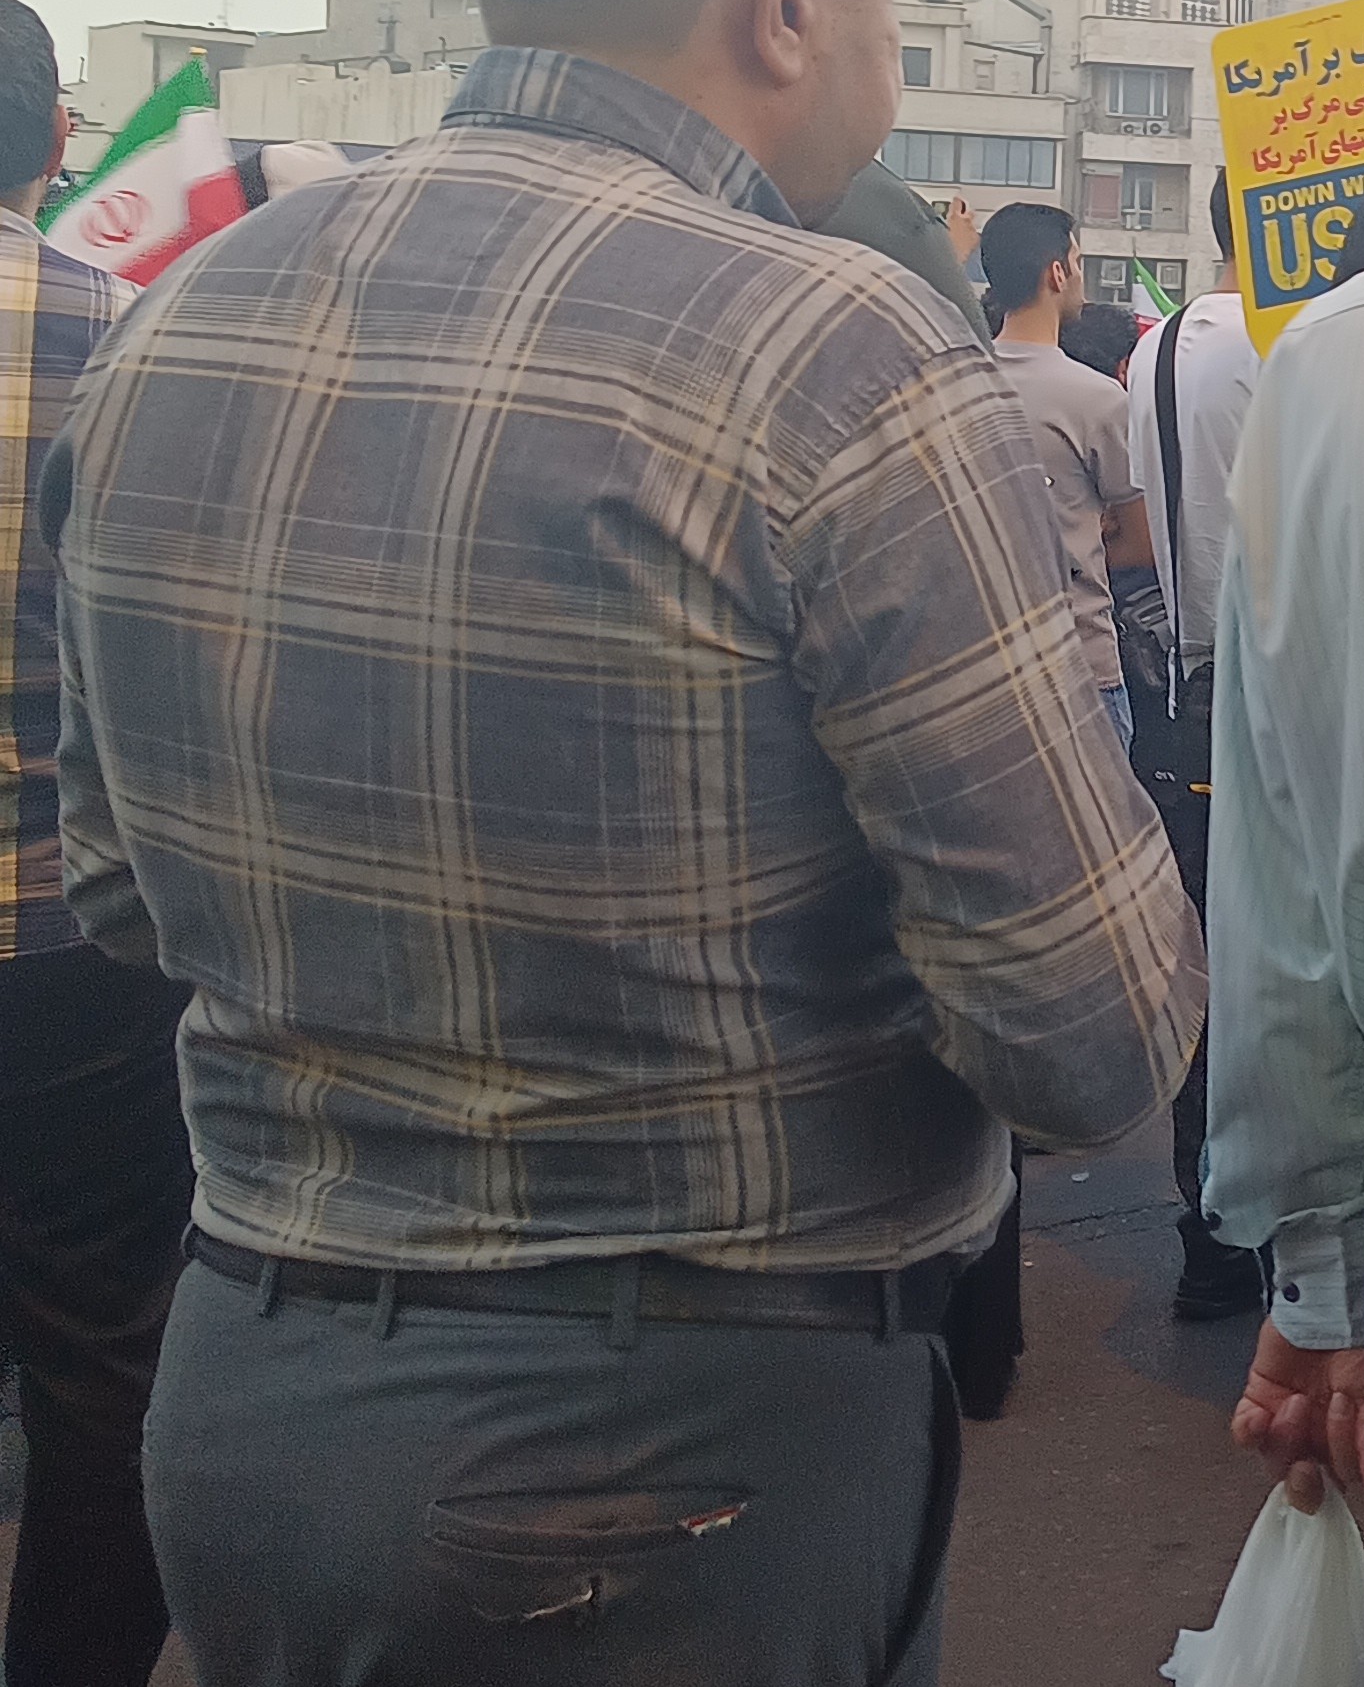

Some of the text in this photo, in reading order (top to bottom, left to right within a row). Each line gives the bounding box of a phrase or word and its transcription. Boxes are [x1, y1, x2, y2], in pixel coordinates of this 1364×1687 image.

[1223, 39, 1311, 97] آمریکا
[1316, 47, 1341, 85] بر
[1269, 106, 1288, 135] بر
[1291, 94, 1341, 124] مرگ
[1252, 132, 1319, 175] آمریکا
[1260, 181, 1335, 215] DOWN
